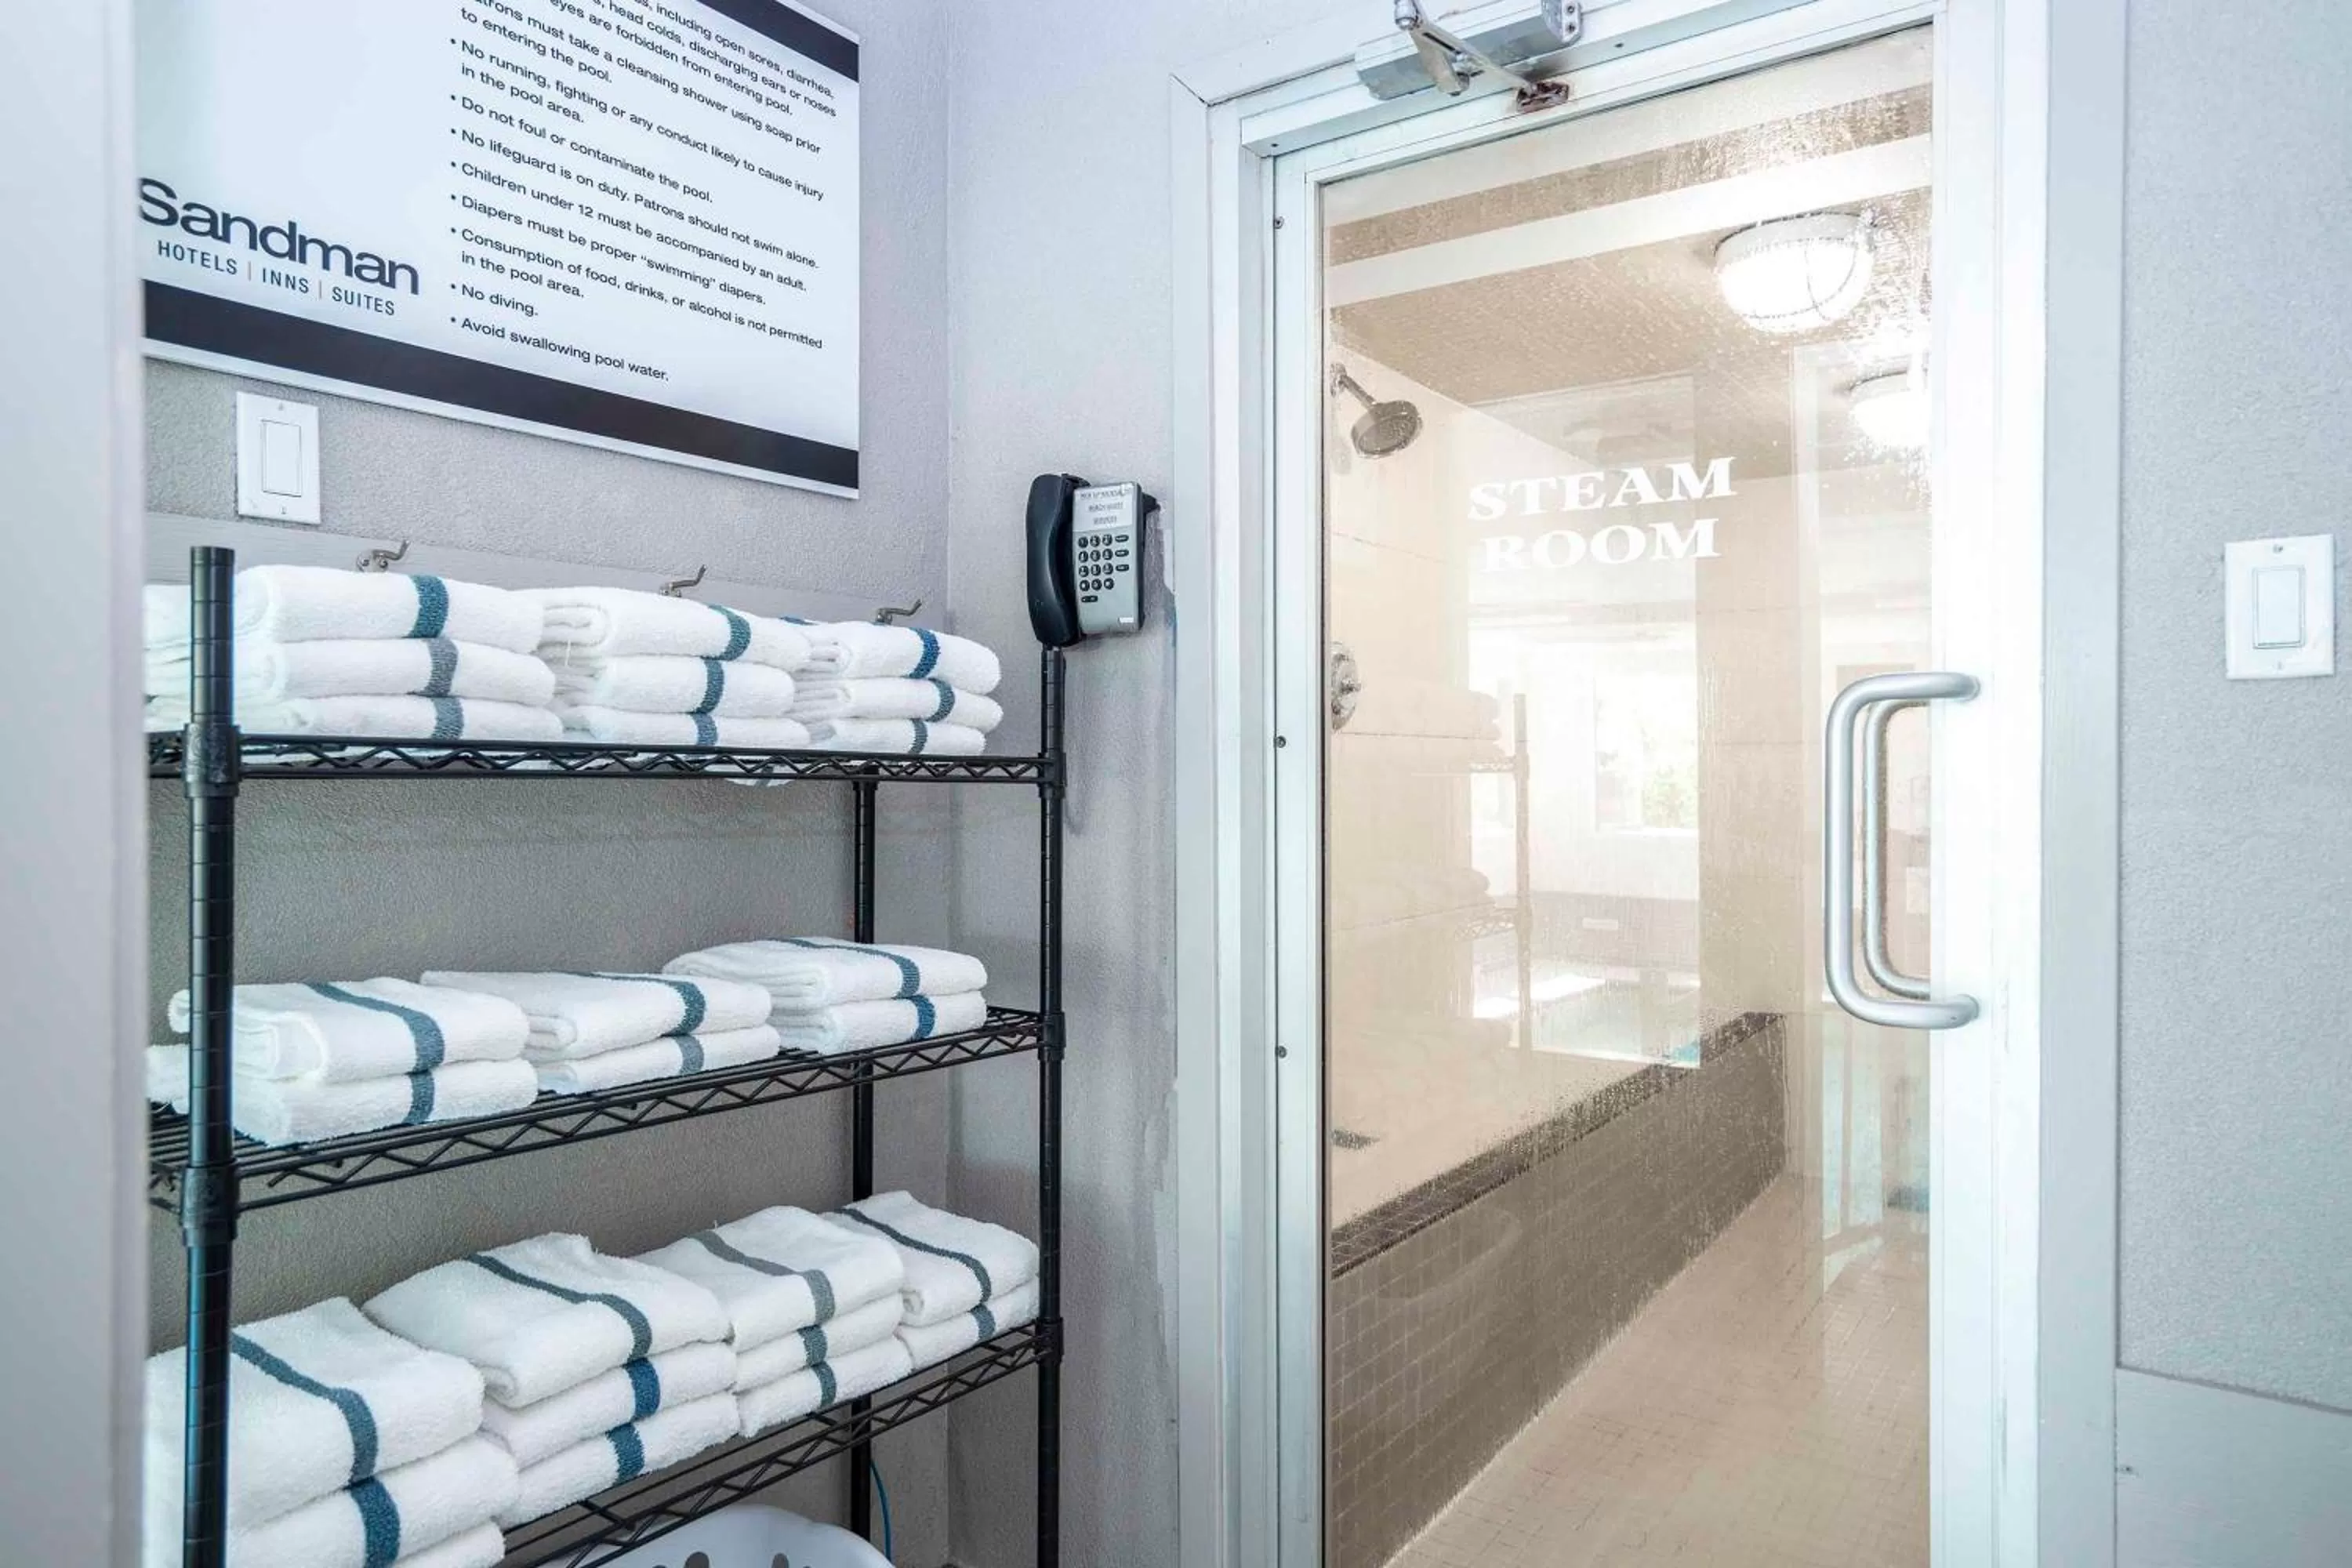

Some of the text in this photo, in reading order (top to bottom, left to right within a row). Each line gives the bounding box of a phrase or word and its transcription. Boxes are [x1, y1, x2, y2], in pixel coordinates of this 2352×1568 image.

[460, 7, 612, 83] to entering the pool.
[528, 16, 564, 41] must
[568, 34, 600, 56] take
[603, 51, 612, 62] a
[616, 57, 679, 94] cleansing
[682, 87, 728, 113] shower
[731, 108, 763, 131] using
[764, 123, 793, 143] soap
[796, 137, 821, 154] prior
[550, 0, 585, 19] eyes
[589, 14, 612, 31] are
[615, 24, 678, 63] forbidden
[681, 56, 711, 78] from
[714, 73, 763, 104] entering
[765, 97, 793, 115] pool.
[609, 0, 644, 26] head
[647, 21, 684, 47] colds,
[689, 41, 758, 82] discharging
[761, 76, 786, 94] ears
[789, 89, 801, 100] or
[804, 96, 837, 117] noses
[656, 2, 712, 41] including
[715, 34, 746, 55] open
[748, 50, 783, 75] sores,
[462, 63, 584, 123] in the pool area.
[462, 40, 824, 201] No running, fighting or any conduct likely to cause injury
[462, 96, 713, 203] Do not foul or contaminate the pool.
[462, 129, 819, 268] No lifeguard is on duty. Patrons should not swim alone.
[140, 177, 419, 295] Sandman
[158, 239, 395, 316] HOTELS INNS SUITES
[462, 162, 807, 292] Children under 12 must be accompanied by an adult.
[462, 195, 523, 225] Diapers
[527, 220, 564, 239] must
[568, 230, 586, 246] be
[590, 241, 637, 262] proper
[719, 281, 766, 305] diapers.
[462, 250, 584, 298] in the pool area.
[462, 228, 822, 349] Consumption of food, drinks, or alcohol is not permitted
[462, 284, 539, 318] No diving.
[461, 318, 669, 382] Avoid swallowing pool water.
[1467, 456, 1737, 521] STEAM
[1479, 517, 1722, 572] ROOM
